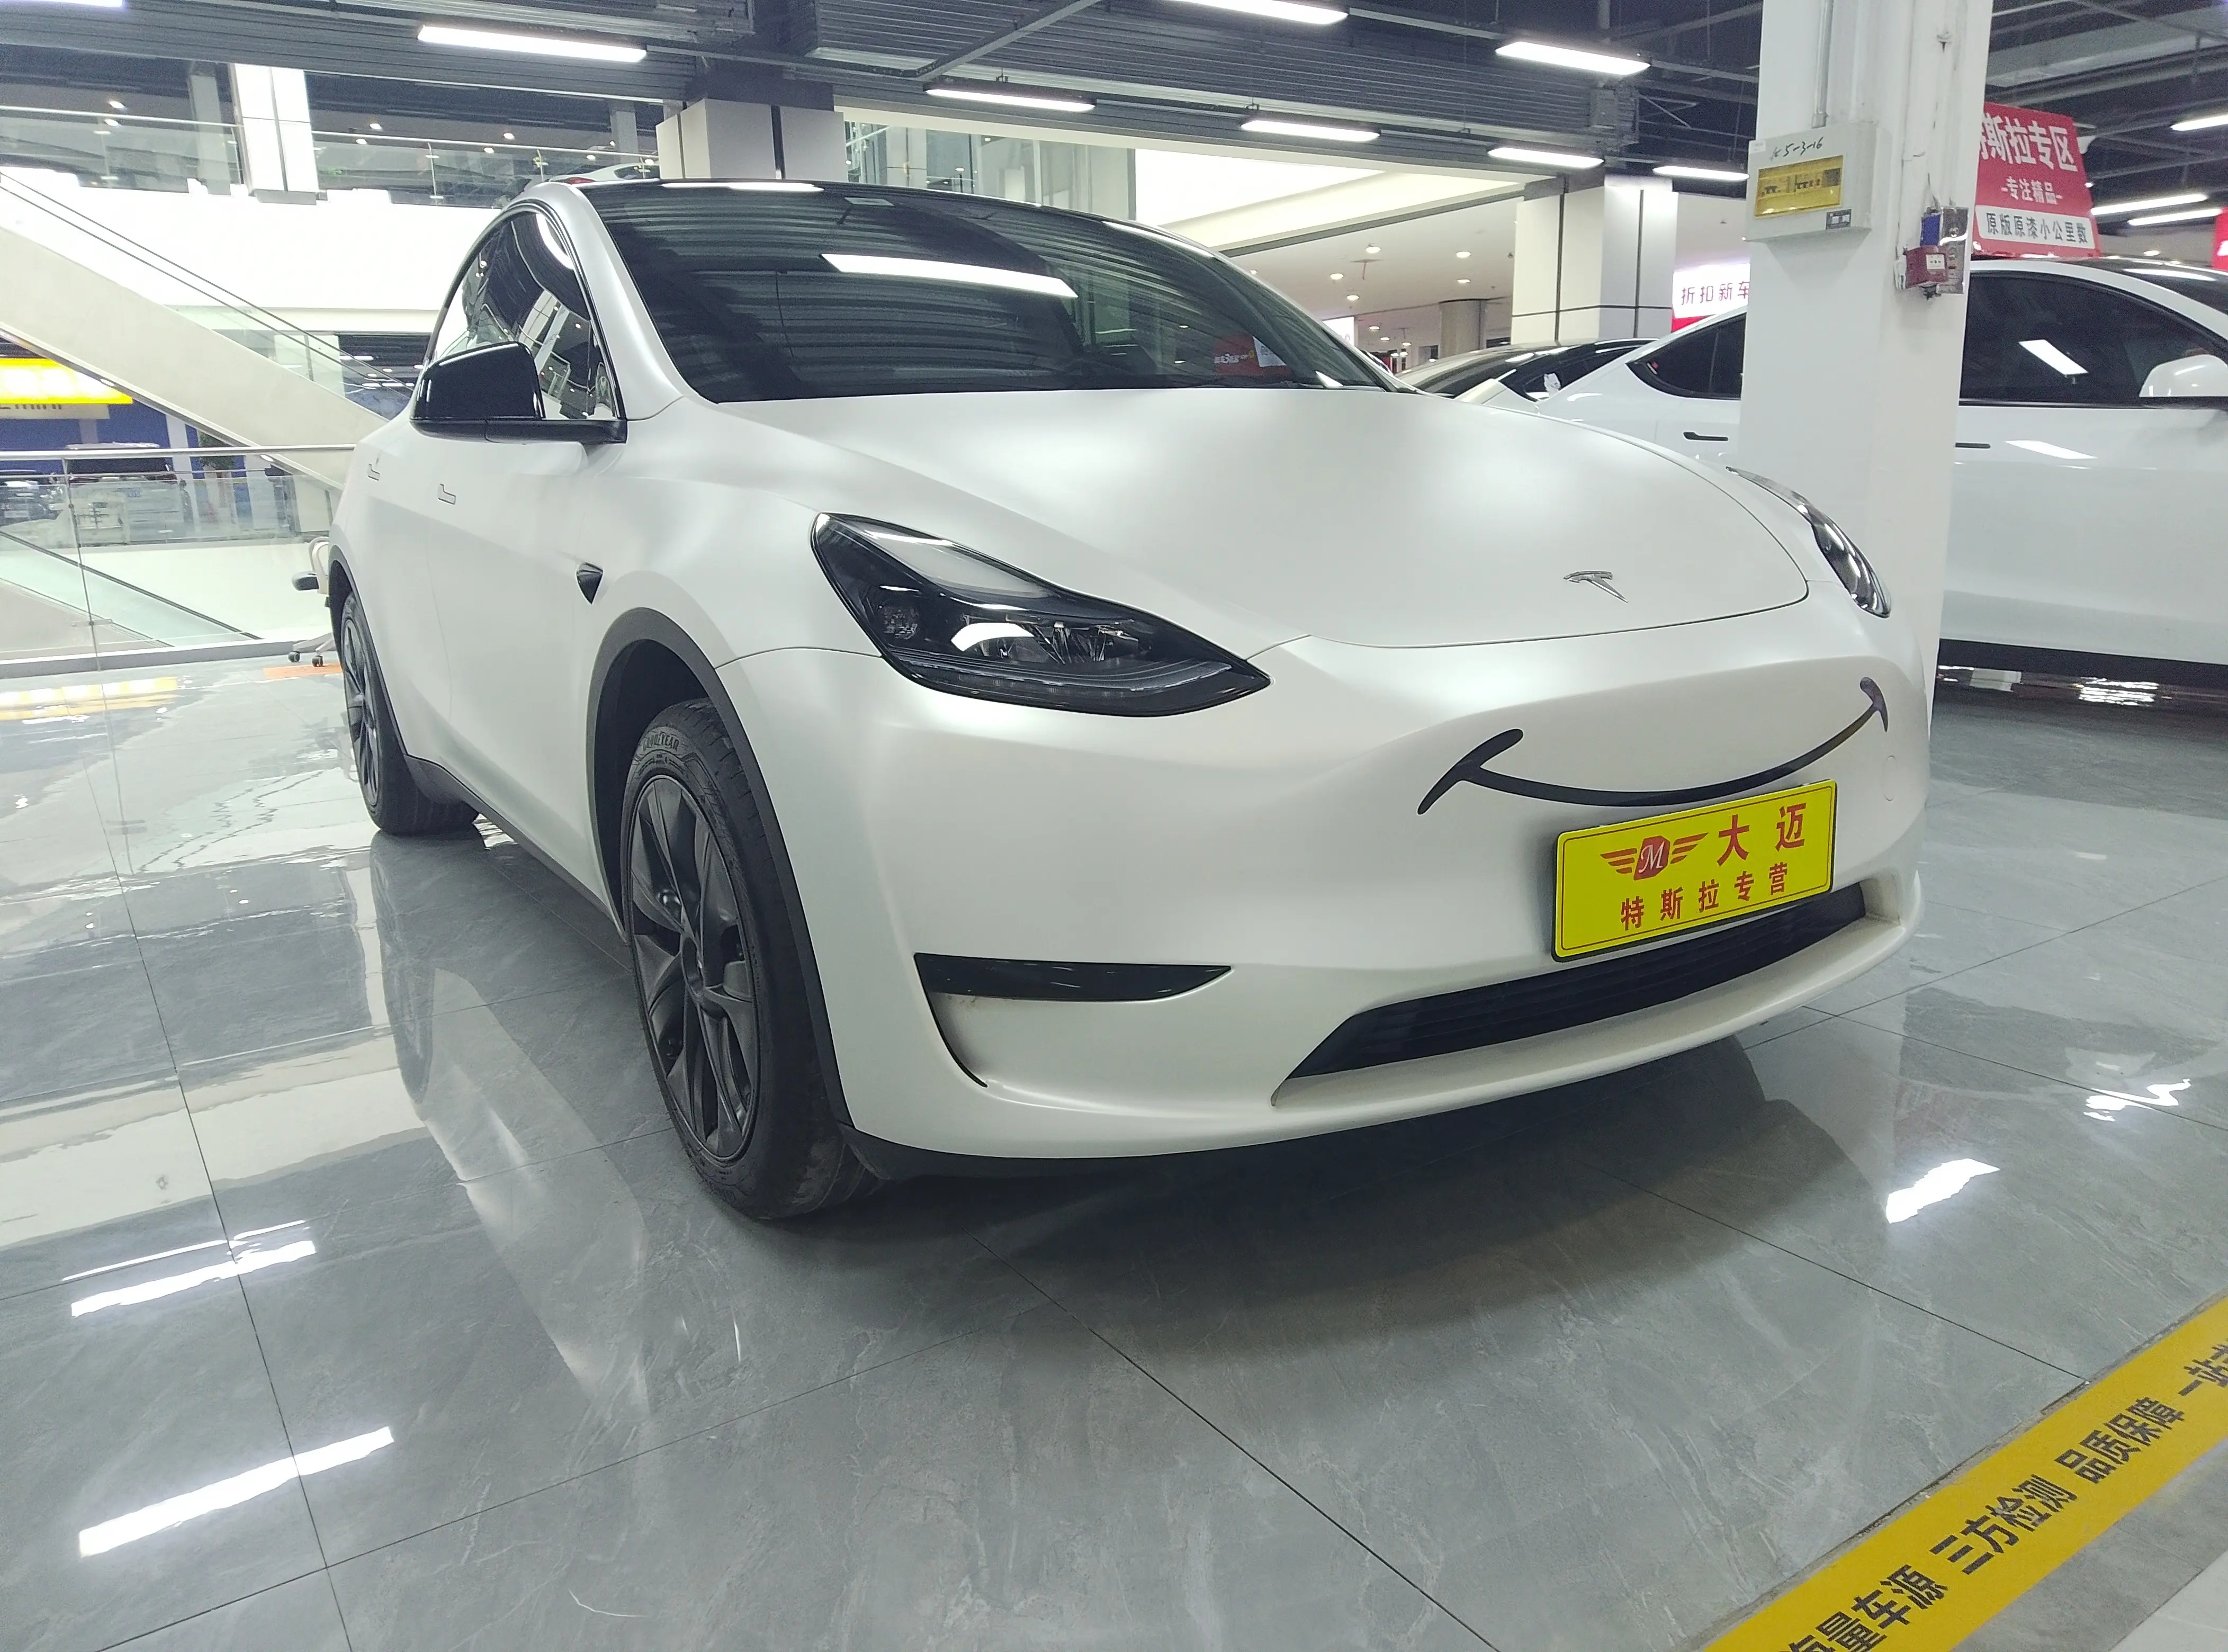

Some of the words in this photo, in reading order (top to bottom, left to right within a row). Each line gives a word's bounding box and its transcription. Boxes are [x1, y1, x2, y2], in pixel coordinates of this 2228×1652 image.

[1986, 212, 2088, 244] 原版原漆小公里数
[1681, 281, 1750, 306] 折扣新车
[1716, 802, 1807, 866] 大迈
[1620, 861, 1788, 931] 特斯拉专营
[1929, 1474, 2078, 1576] 三方检测
[2054, 1396, 2186, 1484] 品质保障
